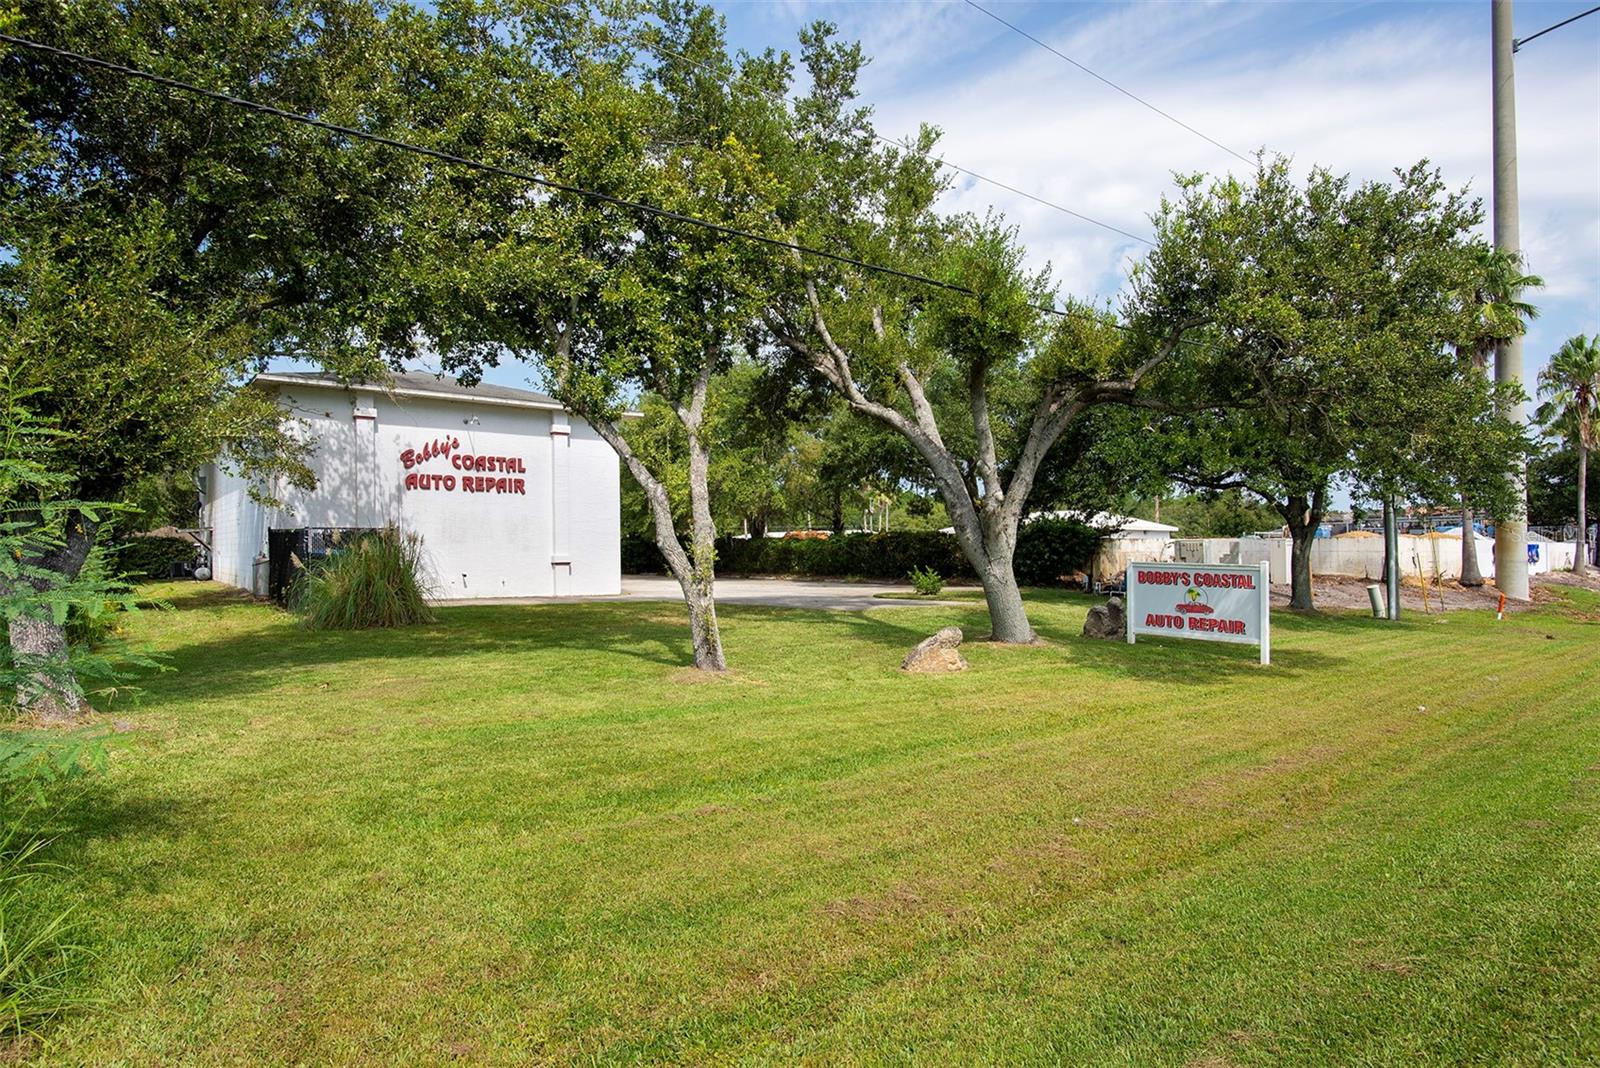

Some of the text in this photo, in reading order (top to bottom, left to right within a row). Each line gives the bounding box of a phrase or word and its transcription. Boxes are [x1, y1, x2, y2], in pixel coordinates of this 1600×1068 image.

[399, 434, 460, 469] Bobby's
[451, 454, 526, 474] COASTAL
[405, 473, 526, 495] AUTO REPAIR
[1137, 570, 1256, 590] BOBBY'S COASTAL
[1145, 613, 1247, 635] AUTO REPAIR
